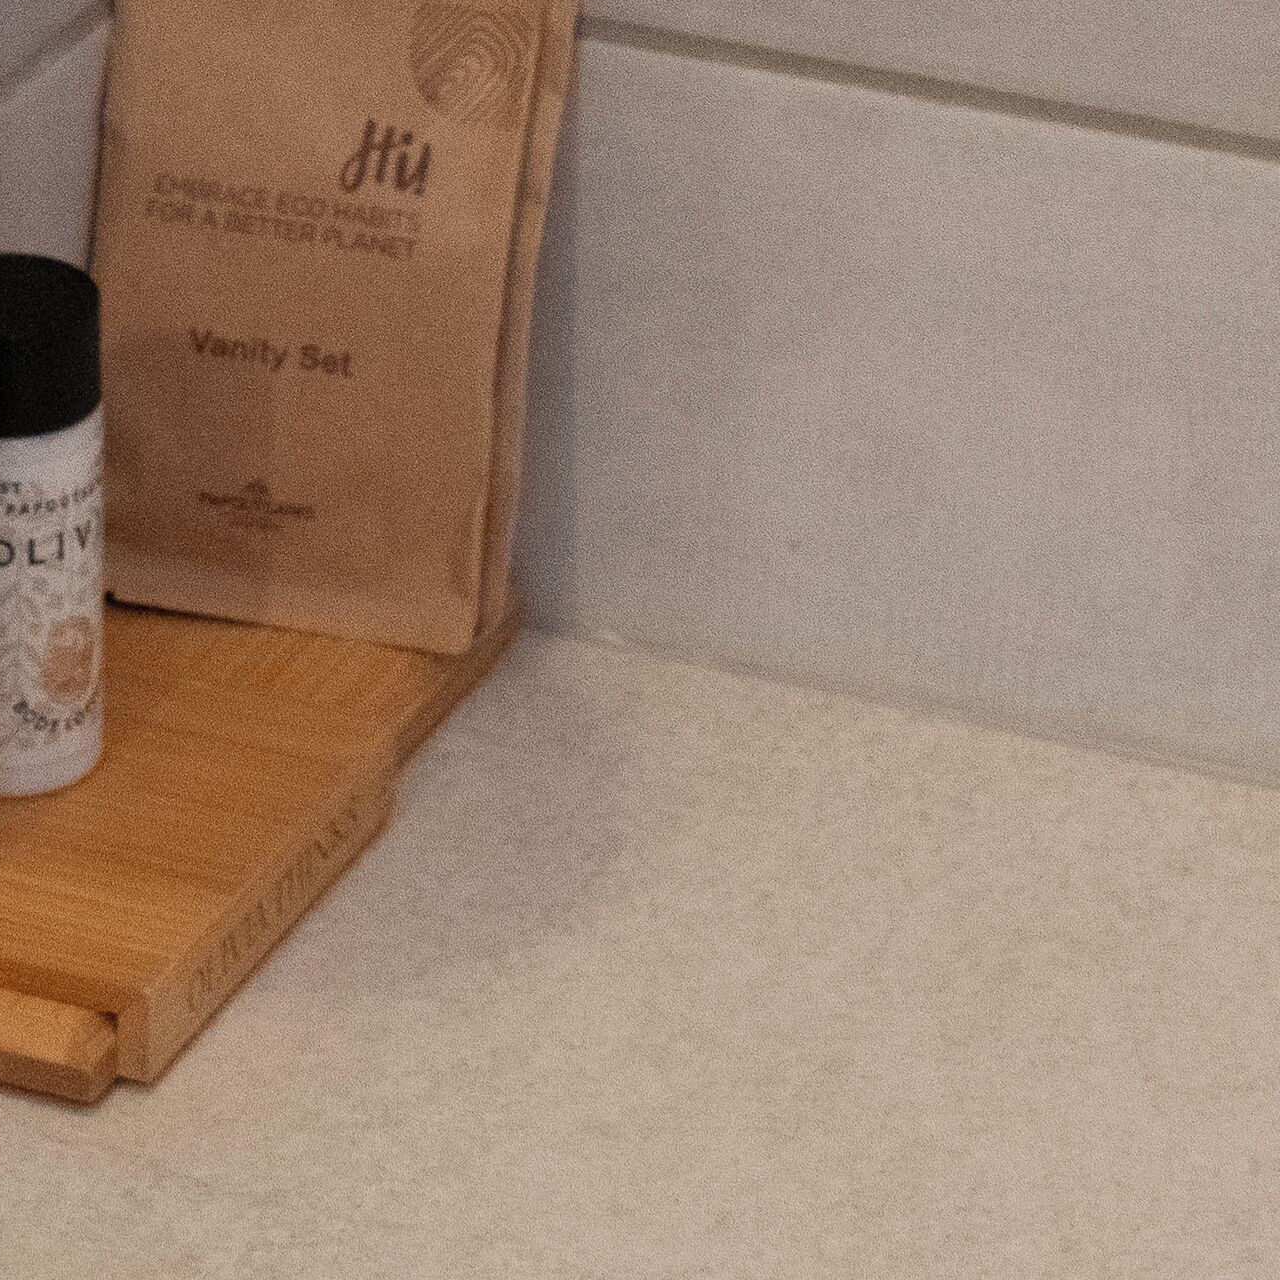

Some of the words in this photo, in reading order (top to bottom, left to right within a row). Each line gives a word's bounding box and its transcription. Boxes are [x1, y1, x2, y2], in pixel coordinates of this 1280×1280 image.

[340, 118, 433, 197] Hi!
[144, 197, 195, 224] FOR
[200, 208, 219, 230] A
[224, 209, 317, 243] BETTER
[321, 225, 418, 260] PLANET
[153, 172, 268, 208] EMBRACE
[274, 190, 327, 220] ECO
[333, 202, 421, 233] HABITS
[189, 327, 290, 372] Vanity
[298, 343, 354, 378] Set
